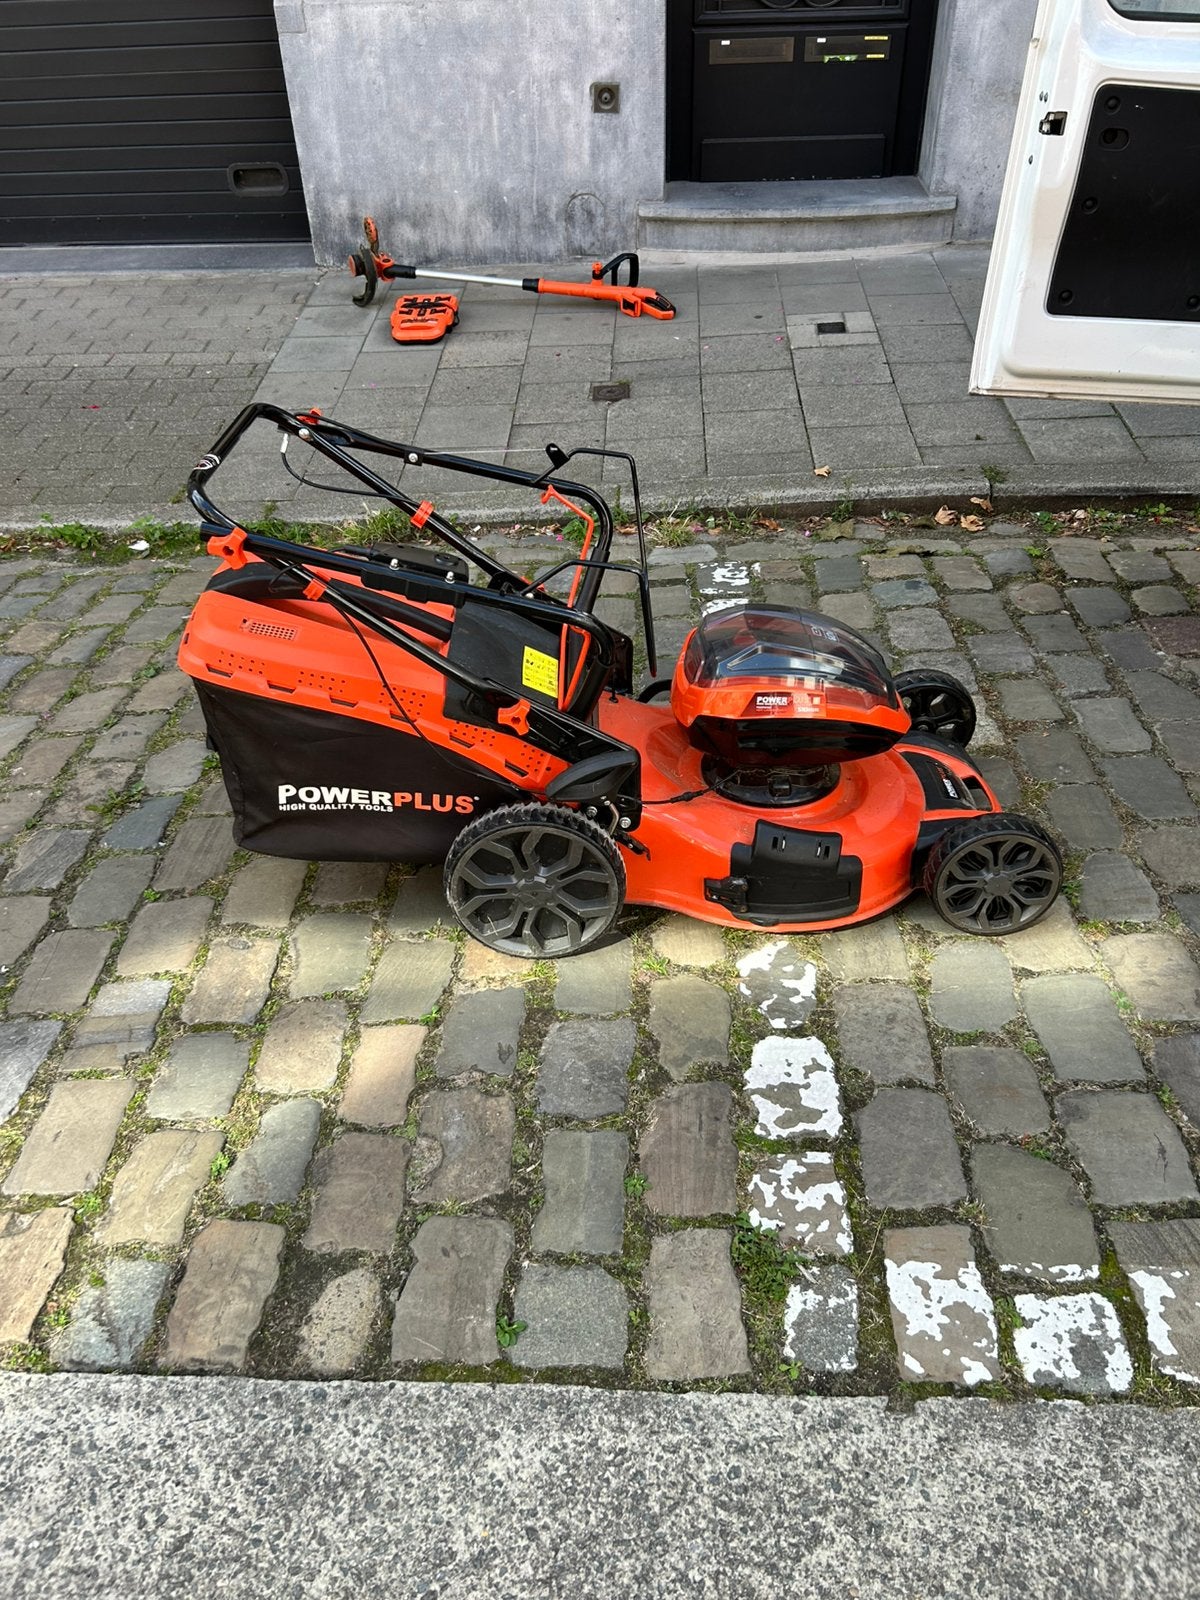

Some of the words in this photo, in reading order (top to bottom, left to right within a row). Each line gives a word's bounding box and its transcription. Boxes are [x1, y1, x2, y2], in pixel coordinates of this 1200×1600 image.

[756, 696, 811, 705] POWERP
[278, 784, 475, 814] POWERPLUS
[279, 803, 306, 811] HIGH
[309, 803, 355, 811] QUALITY
[359, 804, 393, 812] TOOLS
